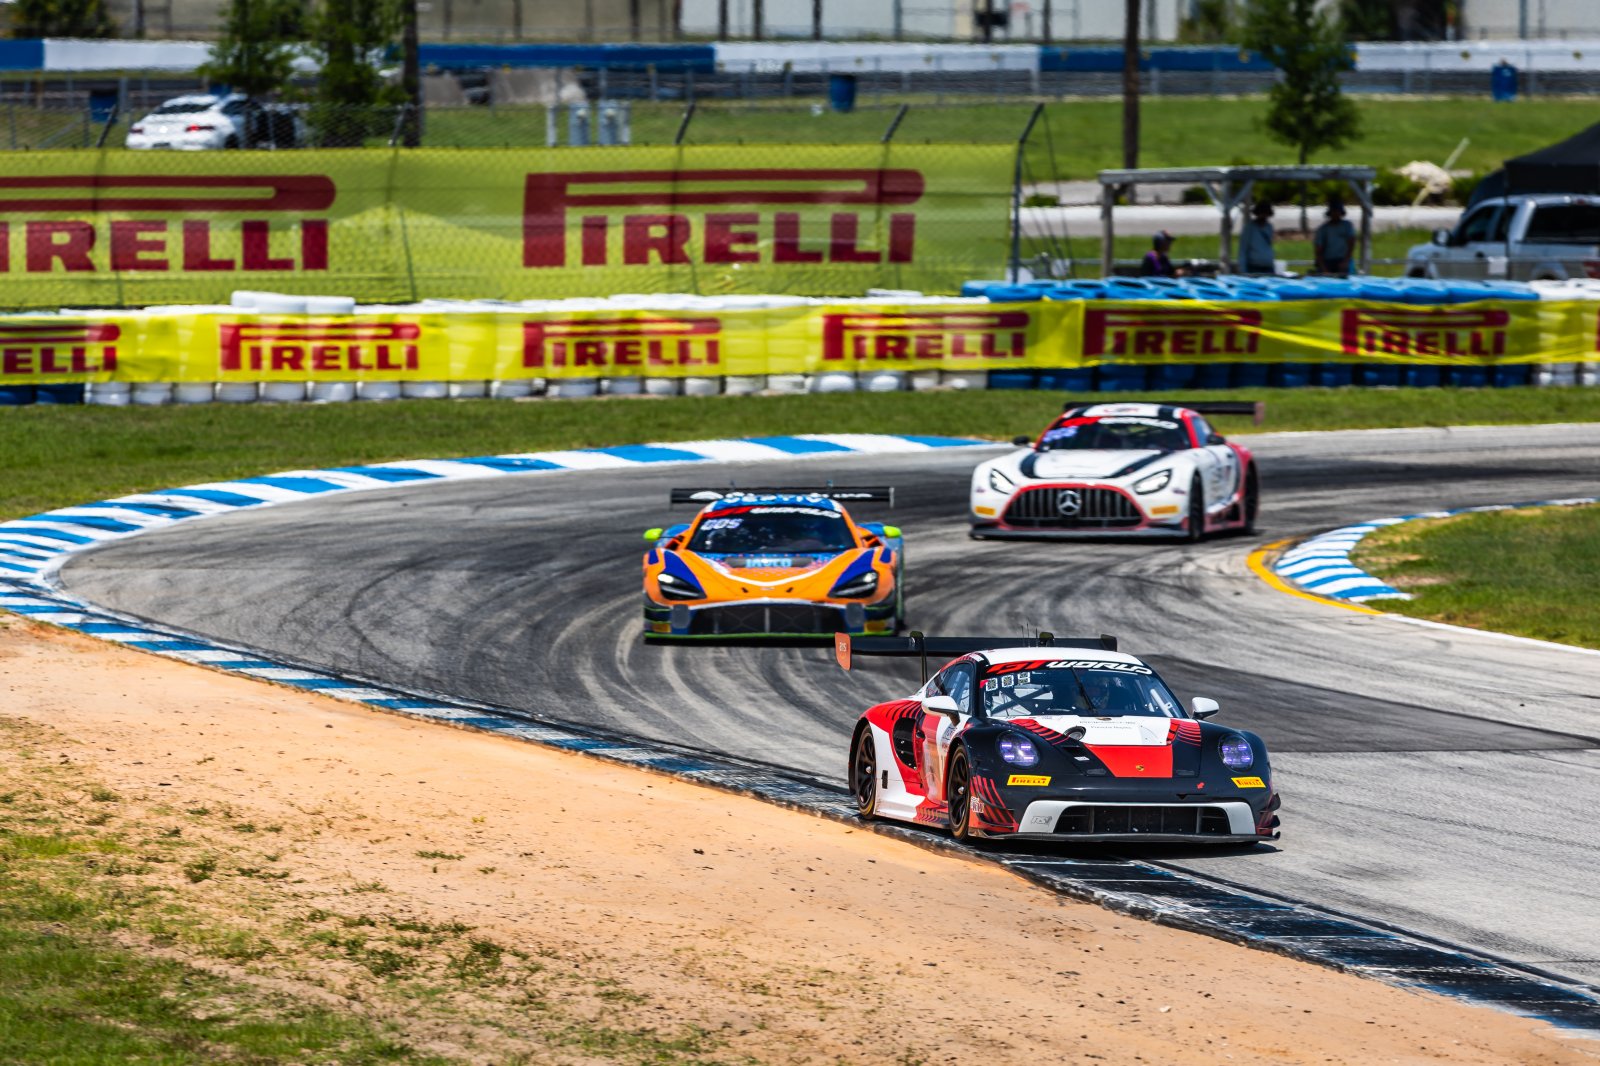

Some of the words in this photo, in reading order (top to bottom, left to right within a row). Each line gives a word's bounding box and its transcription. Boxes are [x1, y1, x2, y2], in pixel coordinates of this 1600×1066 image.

[523, 169, 925, 268] PIRELLI
[0, 323, 121, 374] ELLI
[220, 323, 421, 371] PIRELLI
[523, 317, 722, 369] PIRELLI
[823, 312, 1030, 360] PIRELLI
[1084, 309, 1263, 356] PIRELLI
[1341, 308, 1510, 356] PIRELLI
[1045, 661, 1153, 675] WORLD
